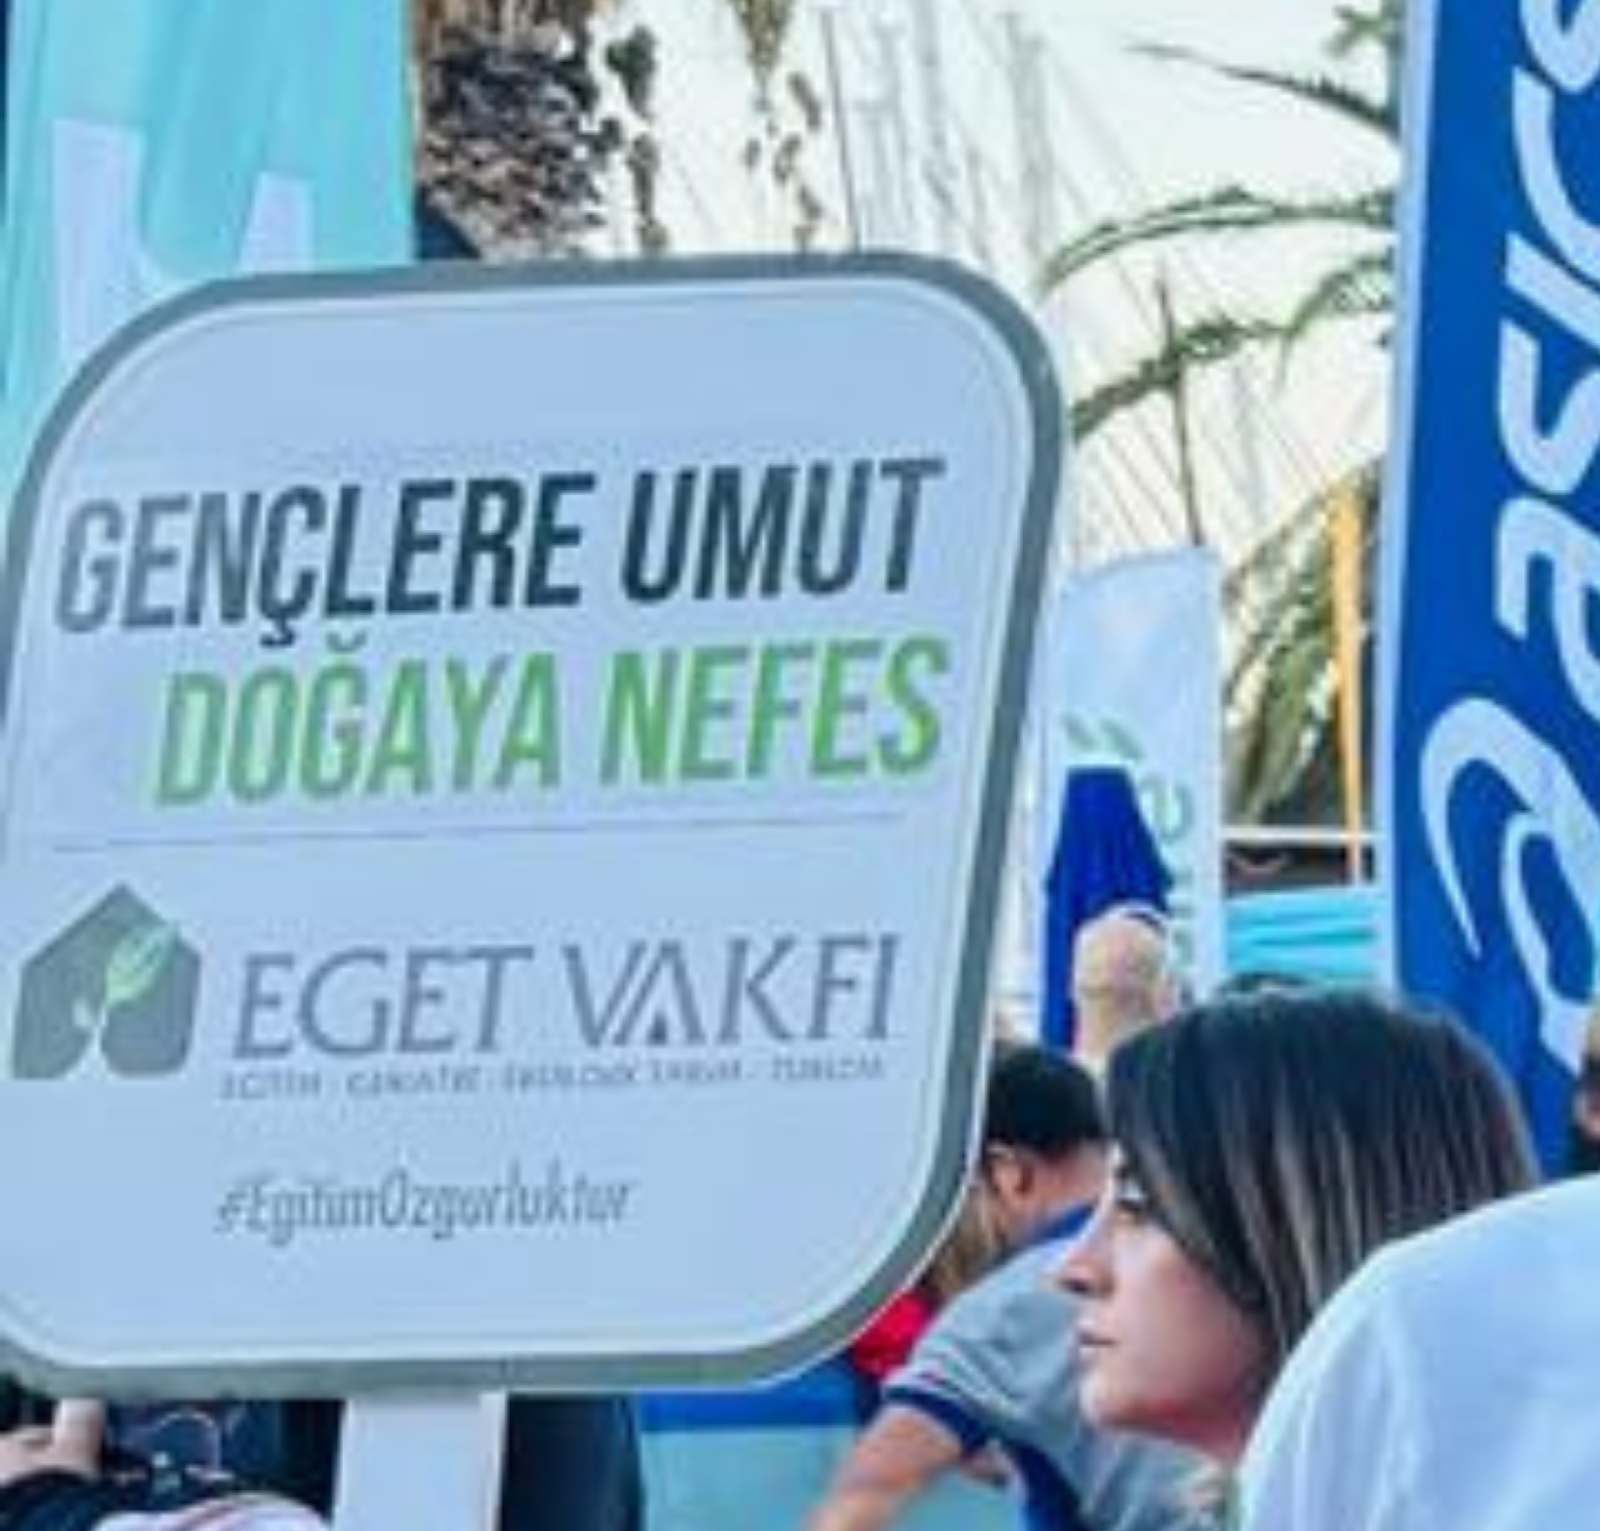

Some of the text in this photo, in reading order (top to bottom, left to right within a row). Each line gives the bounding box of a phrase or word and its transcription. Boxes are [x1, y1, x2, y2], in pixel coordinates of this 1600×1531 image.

[53, 457, 945, 648] GENÇLERE UMUT
[154, 633, 949, 806] DOĞAYA NEFES
[231, 930, 900, 1062] EGET VAKFI
